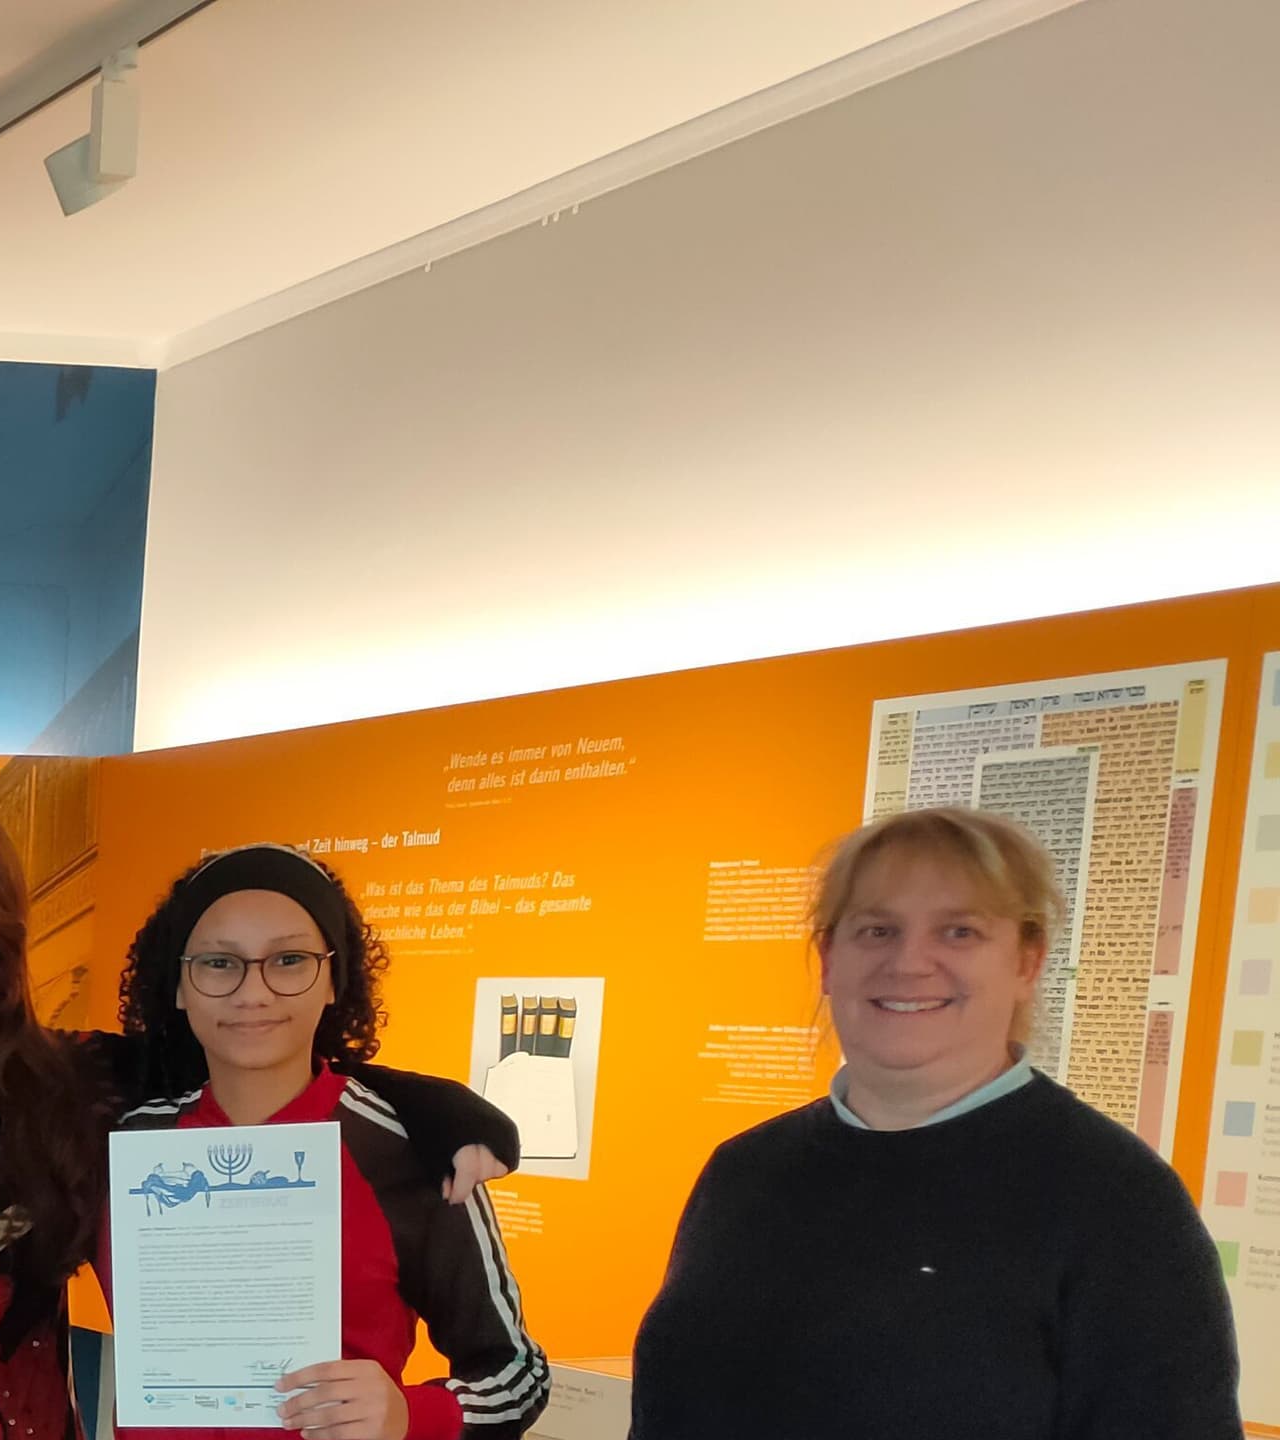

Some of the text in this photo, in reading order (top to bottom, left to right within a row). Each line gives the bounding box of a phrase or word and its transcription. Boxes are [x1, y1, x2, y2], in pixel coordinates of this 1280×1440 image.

[491, 750, 504, 765] es
[508, 745, 547, 763] immer
[551, 741, 572, 758] von
[576, 736, 626, 755] Neuem,
[447, 775, 476, 793] denn
[479, 772, 507, 790] alles
[510, 769, 526, 788] ist
[529, 766, 561, 784] darin
[312, 838, 331, 854] Zeit
[334, 836, 369, 854] hinweg
[381, 832, 399, 849] der
[402, 827, 441, 847] Talmud
[389, 879, 403, 896] ist
[406, 878, 424, 895] das
[429, 877, 464, 895] Thema
[468, 876, 488, 892] des
[493, 871, 549, 891] Talmuds?
[552, 871, 576, 889] Das
[404, 902, 422, 918] wie
[425, 900, 444, 917] das
[448, 899, 466, 916] der
[469, 896, 500, 915] Bibel
[515, 896, 536, 914] das
[539, 894, 593, 917] gesamte
